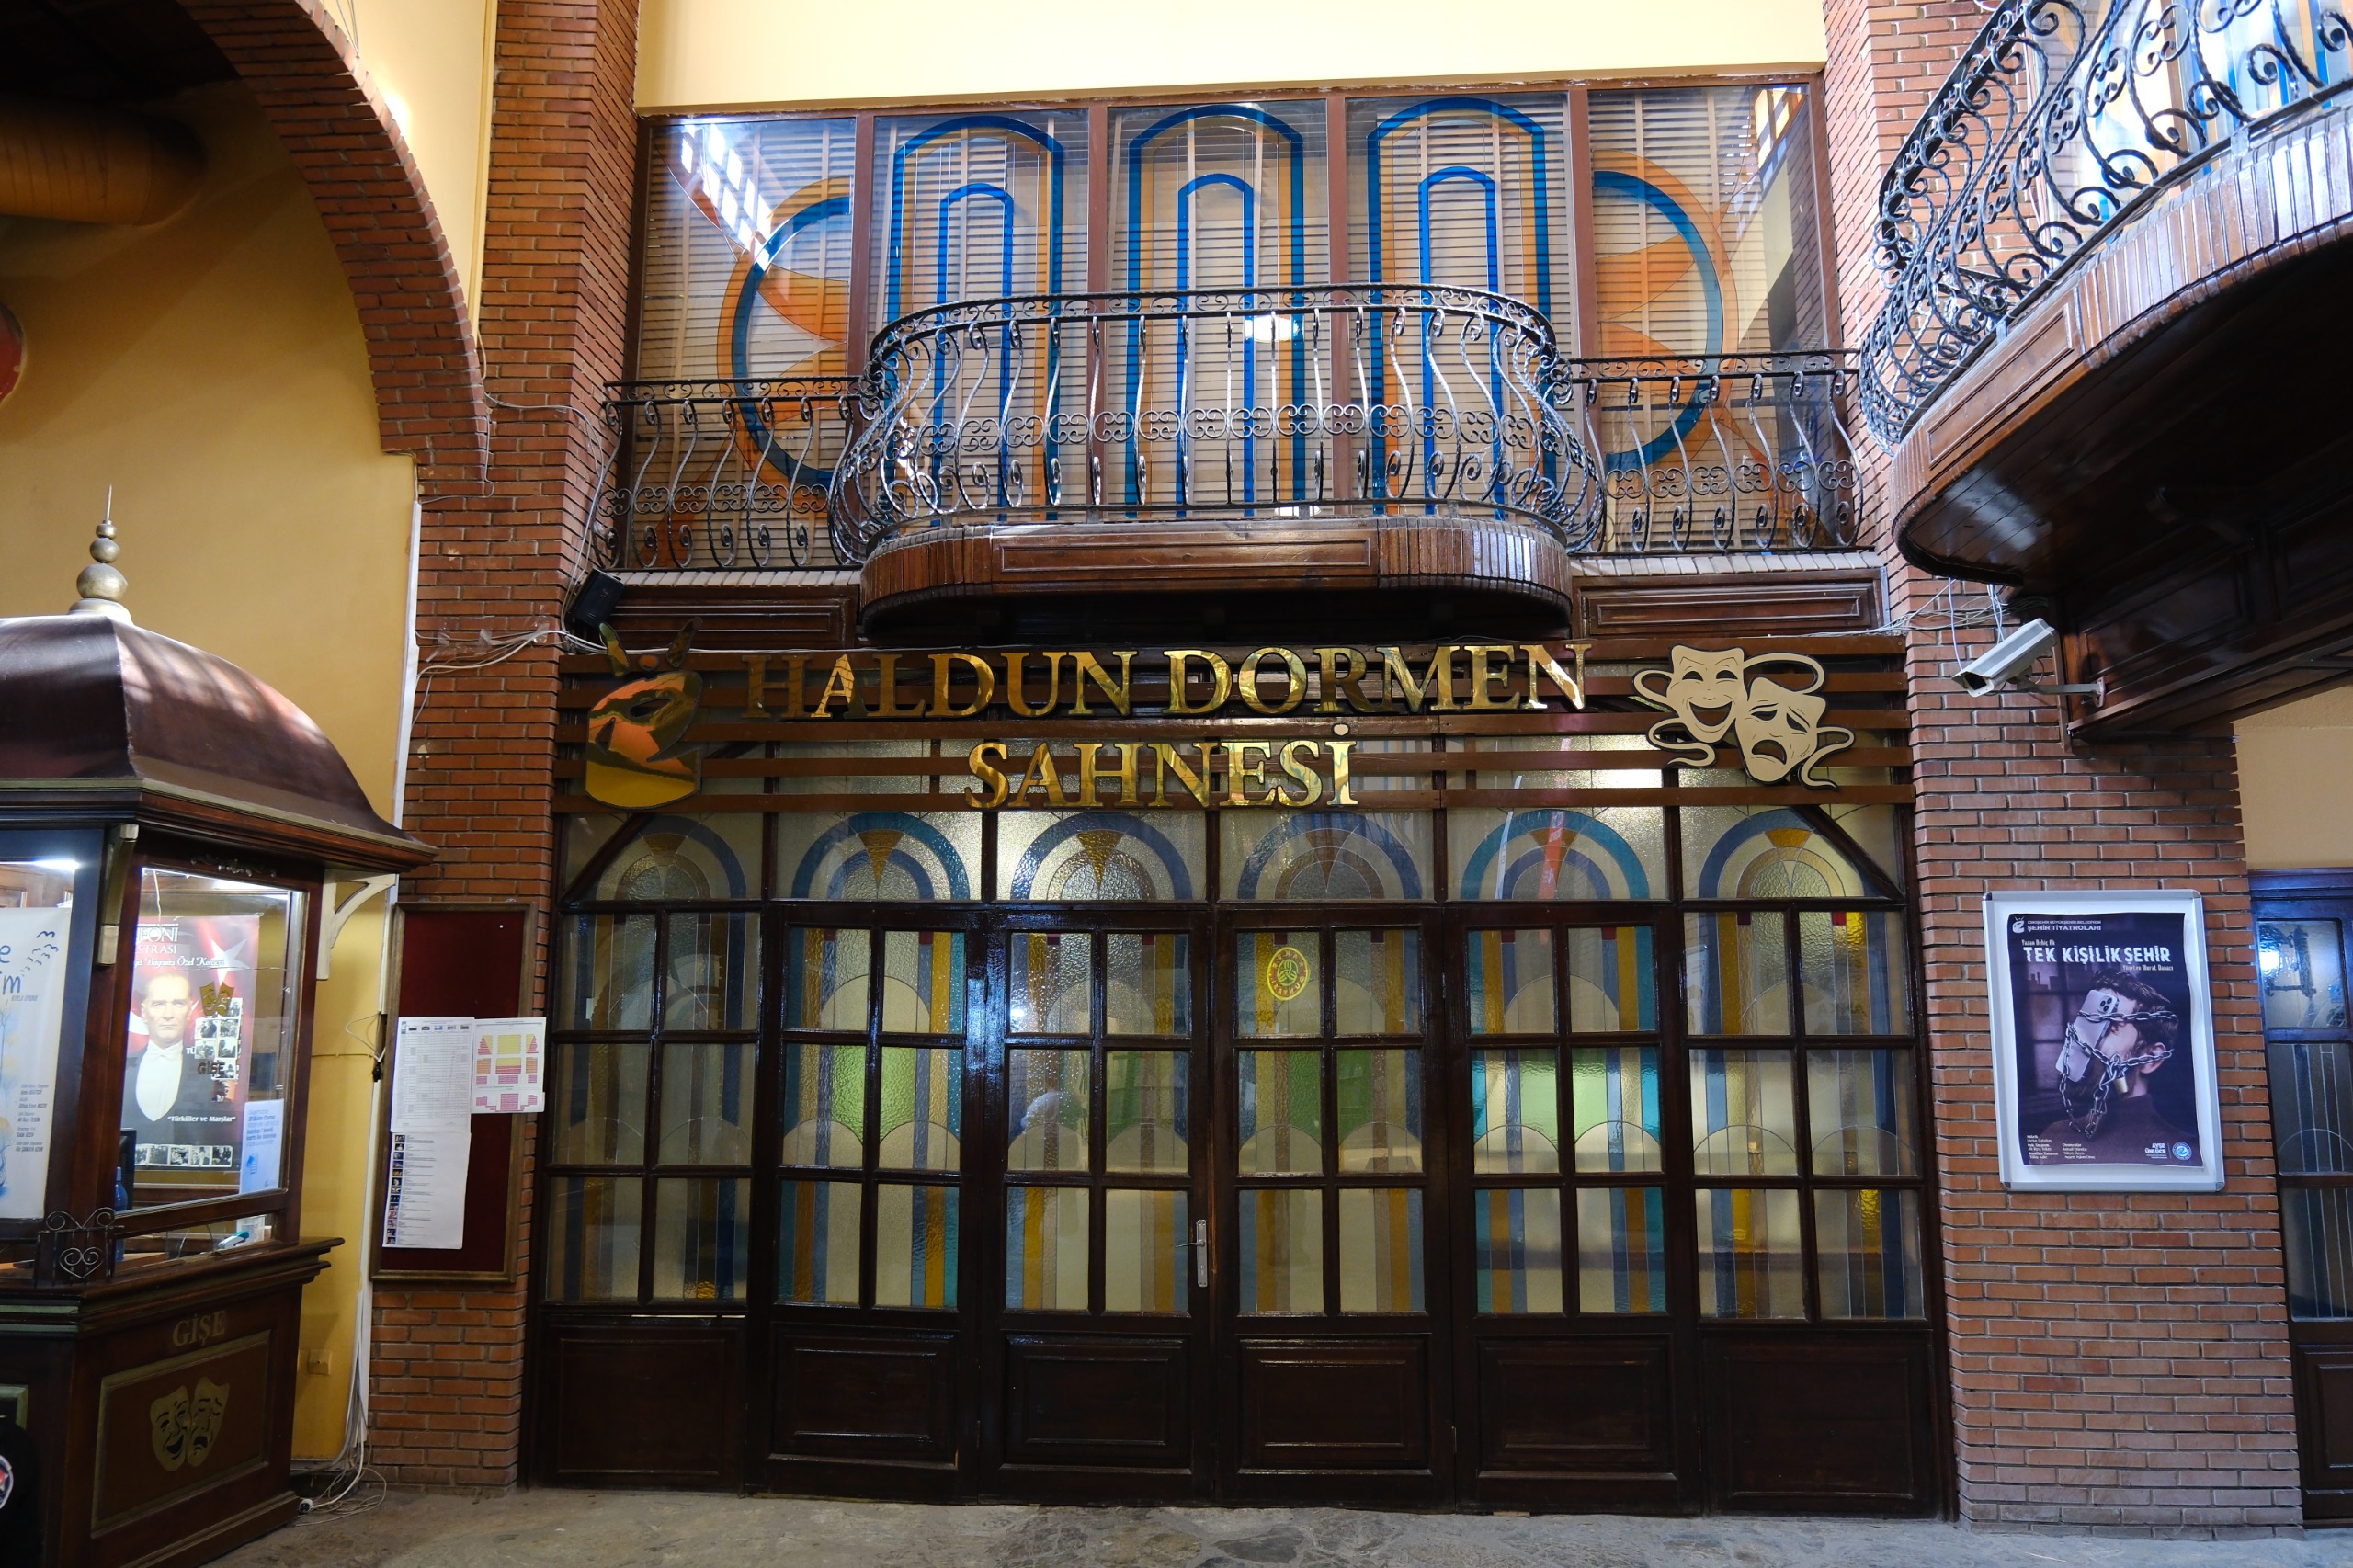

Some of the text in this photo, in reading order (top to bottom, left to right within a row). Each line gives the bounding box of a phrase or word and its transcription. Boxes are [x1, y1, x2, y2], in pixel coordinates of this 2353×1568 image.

[741, 643, 1592, 720] HALDUN DORMEN
[963, 722, 1359, 810] SAHNESİ
[2027, 924, 2051, 932] ŞEHİR
[135, 944, 177, 955] STRASI
[2022, 945, 2172, 964] TEK KİŞİLİK ŞEHİR
[172, 1310, 226, 1346] GİŞE
